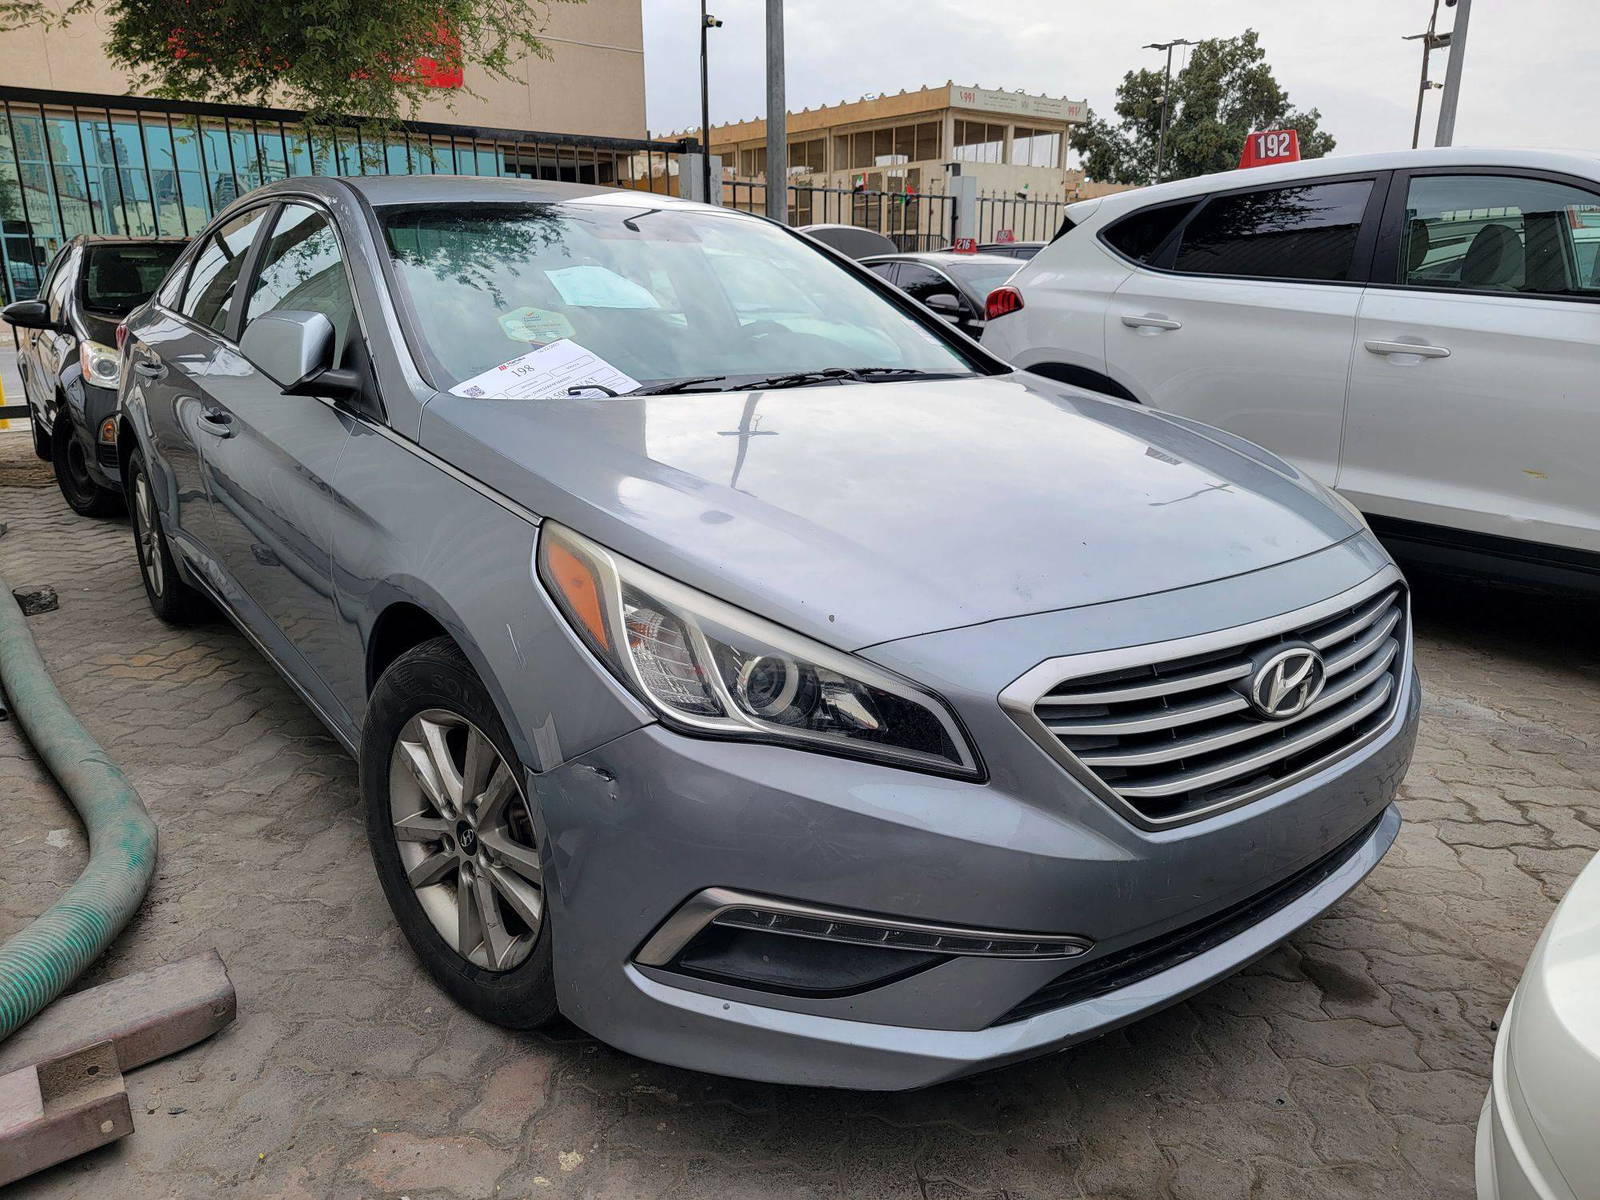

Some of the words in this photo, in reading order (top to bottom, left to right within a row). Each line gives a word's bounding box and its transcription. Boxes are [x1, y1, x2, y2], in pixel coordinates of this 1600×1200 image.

[1257, 133, 1290, 159] 192
[957, 239, 971, 250] 216
[511, 364, 535, 377] 198
